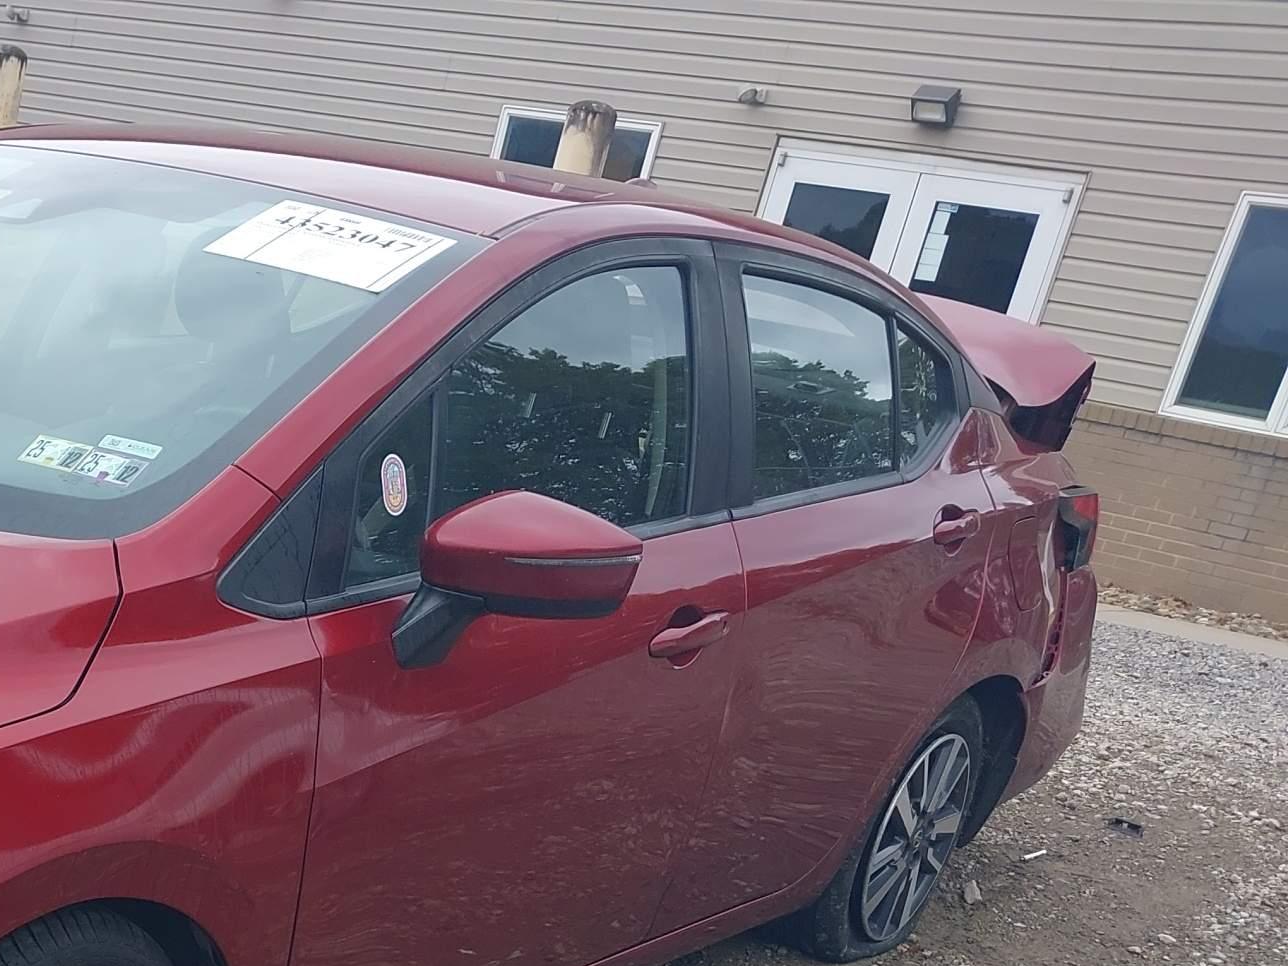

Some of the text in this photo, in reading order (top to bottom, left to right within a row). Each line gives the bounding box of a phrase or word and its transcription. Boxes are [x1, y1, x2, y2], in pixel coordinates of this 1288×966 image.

[275, 215, 417, 252] 43523047
[26, 439, 83, 468] 25 12
[82, 453, 139, 482] 25 12
